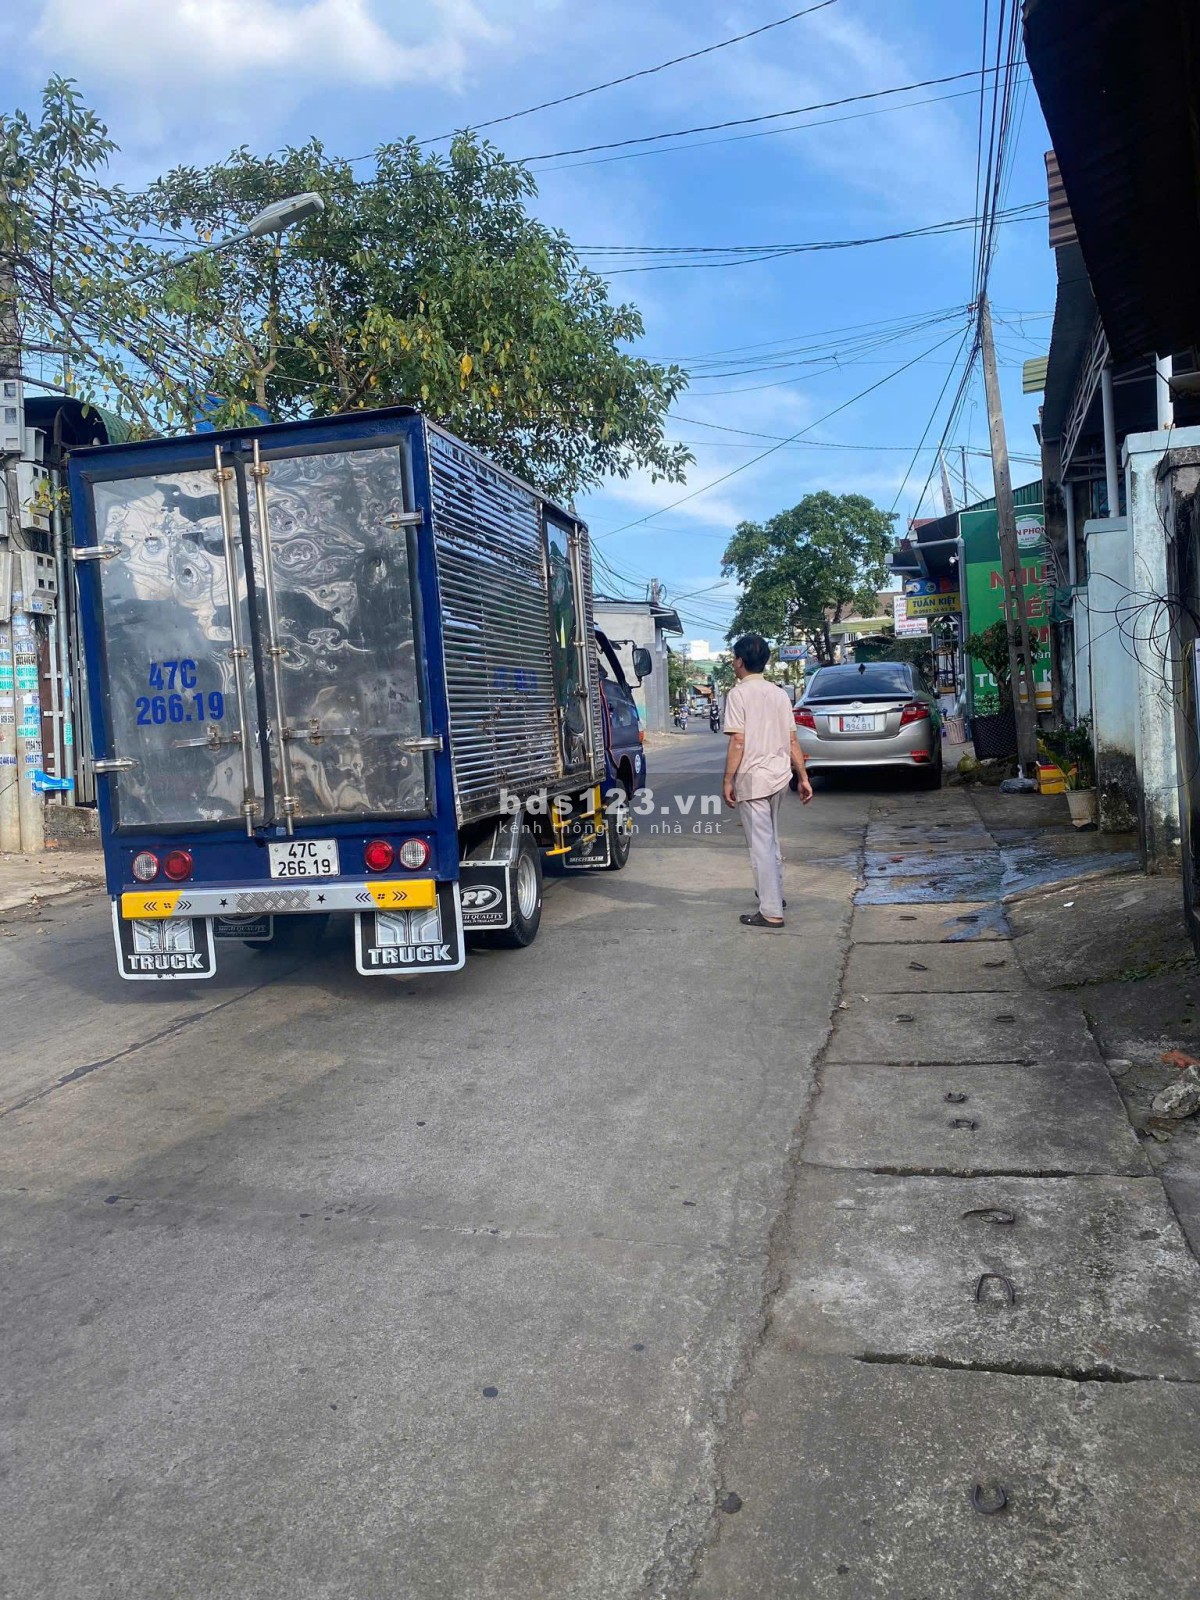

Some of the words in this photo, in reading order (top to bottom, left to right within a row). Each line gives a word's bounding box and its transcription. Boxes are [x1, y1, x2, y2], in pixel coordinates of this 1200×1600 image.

[1023, 527, 1045, 535] PHON
[912, 597, 936, 608] TUẤN
[938, 596, 956, 607] KIỆT
[149, 659, 197, 690] 47C
[136, 692, 224, 726] 266.19
[288, 842, 317, 858] 47C
[279, 859, 331, 876] 266.19
[128, 953, 204, 970] TRUCK
[368, 944, 452, 965] TRUCK
